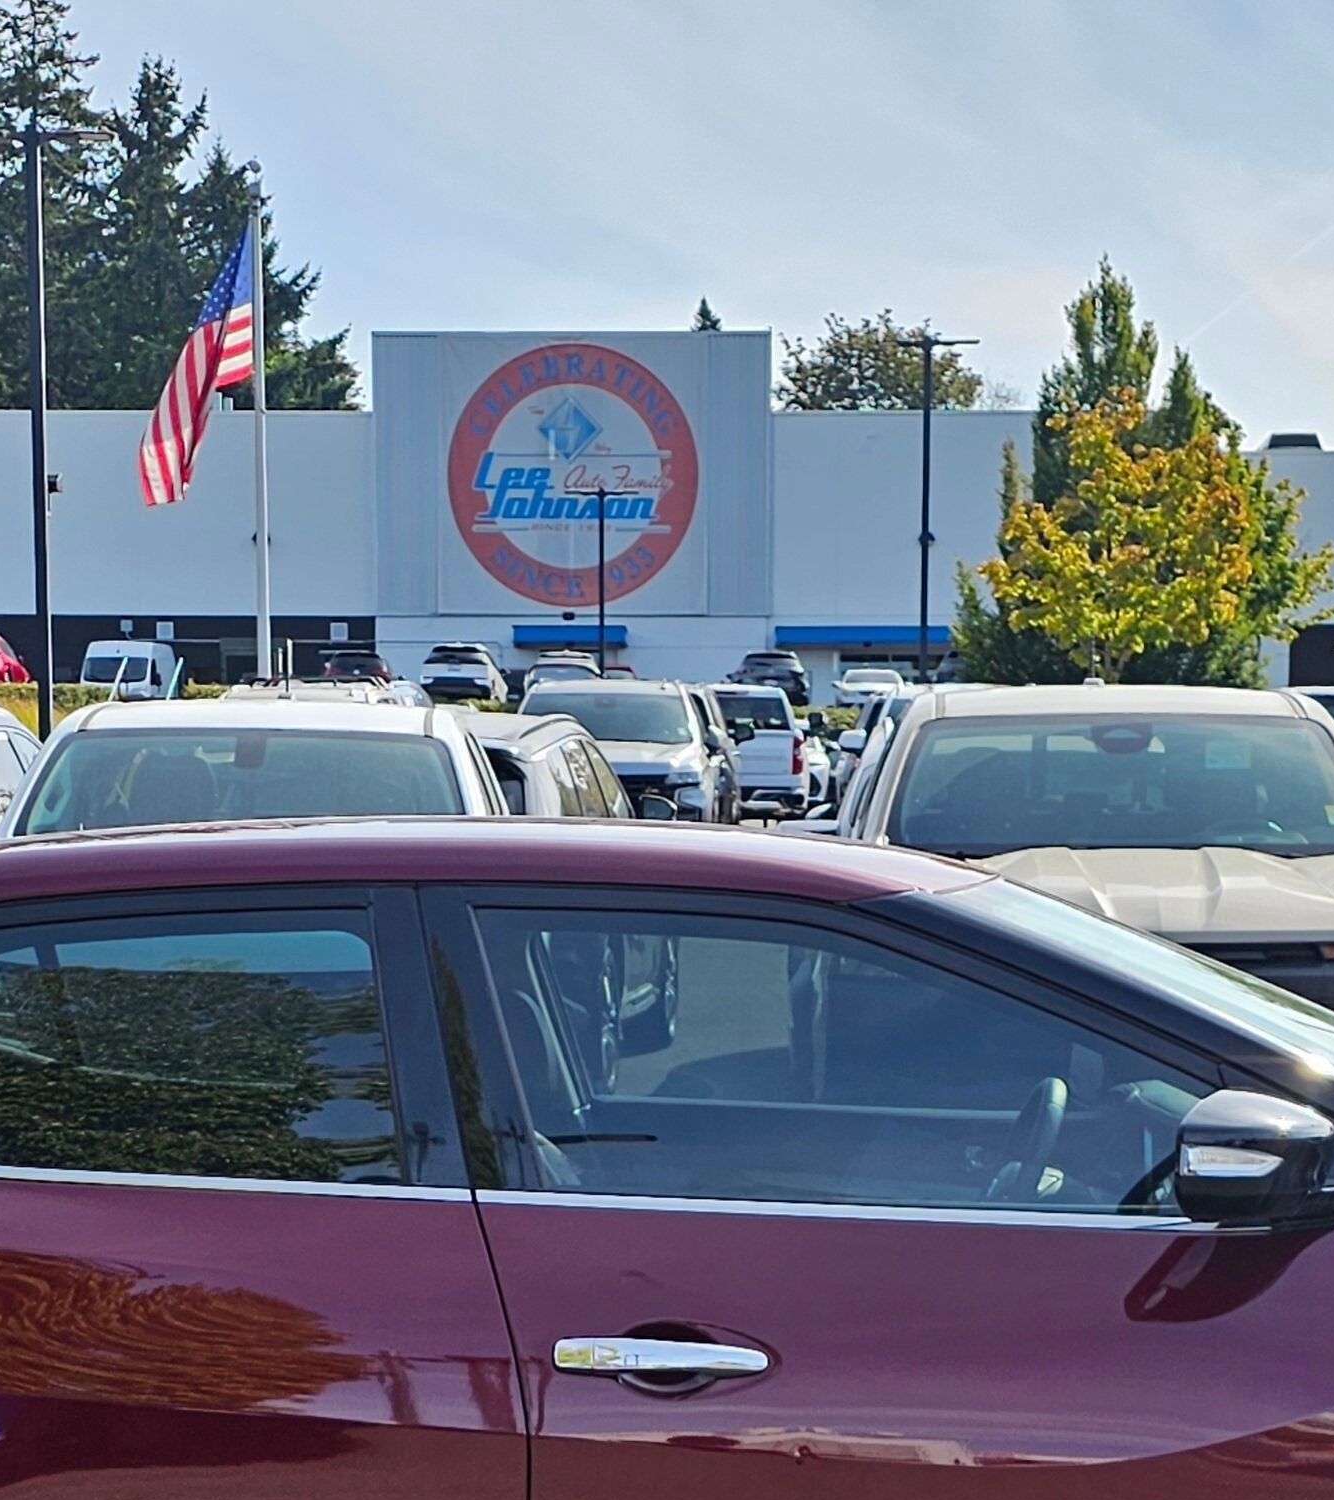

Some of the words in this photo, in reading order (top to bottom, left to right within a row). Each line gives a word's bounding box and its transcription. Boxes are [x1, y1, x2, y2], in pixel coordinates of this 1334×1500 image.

[470, 353, 678, 437] CELEBRATING
[474, 452, 555, 490] Lee
[563, 464, 607, 489] Auto
[611, 464, 674, 495] Family
[477, 486, 658, 519] Johnson
[492, 546, 586, 598] SINCE
[602, 546, 657, 597] 933
